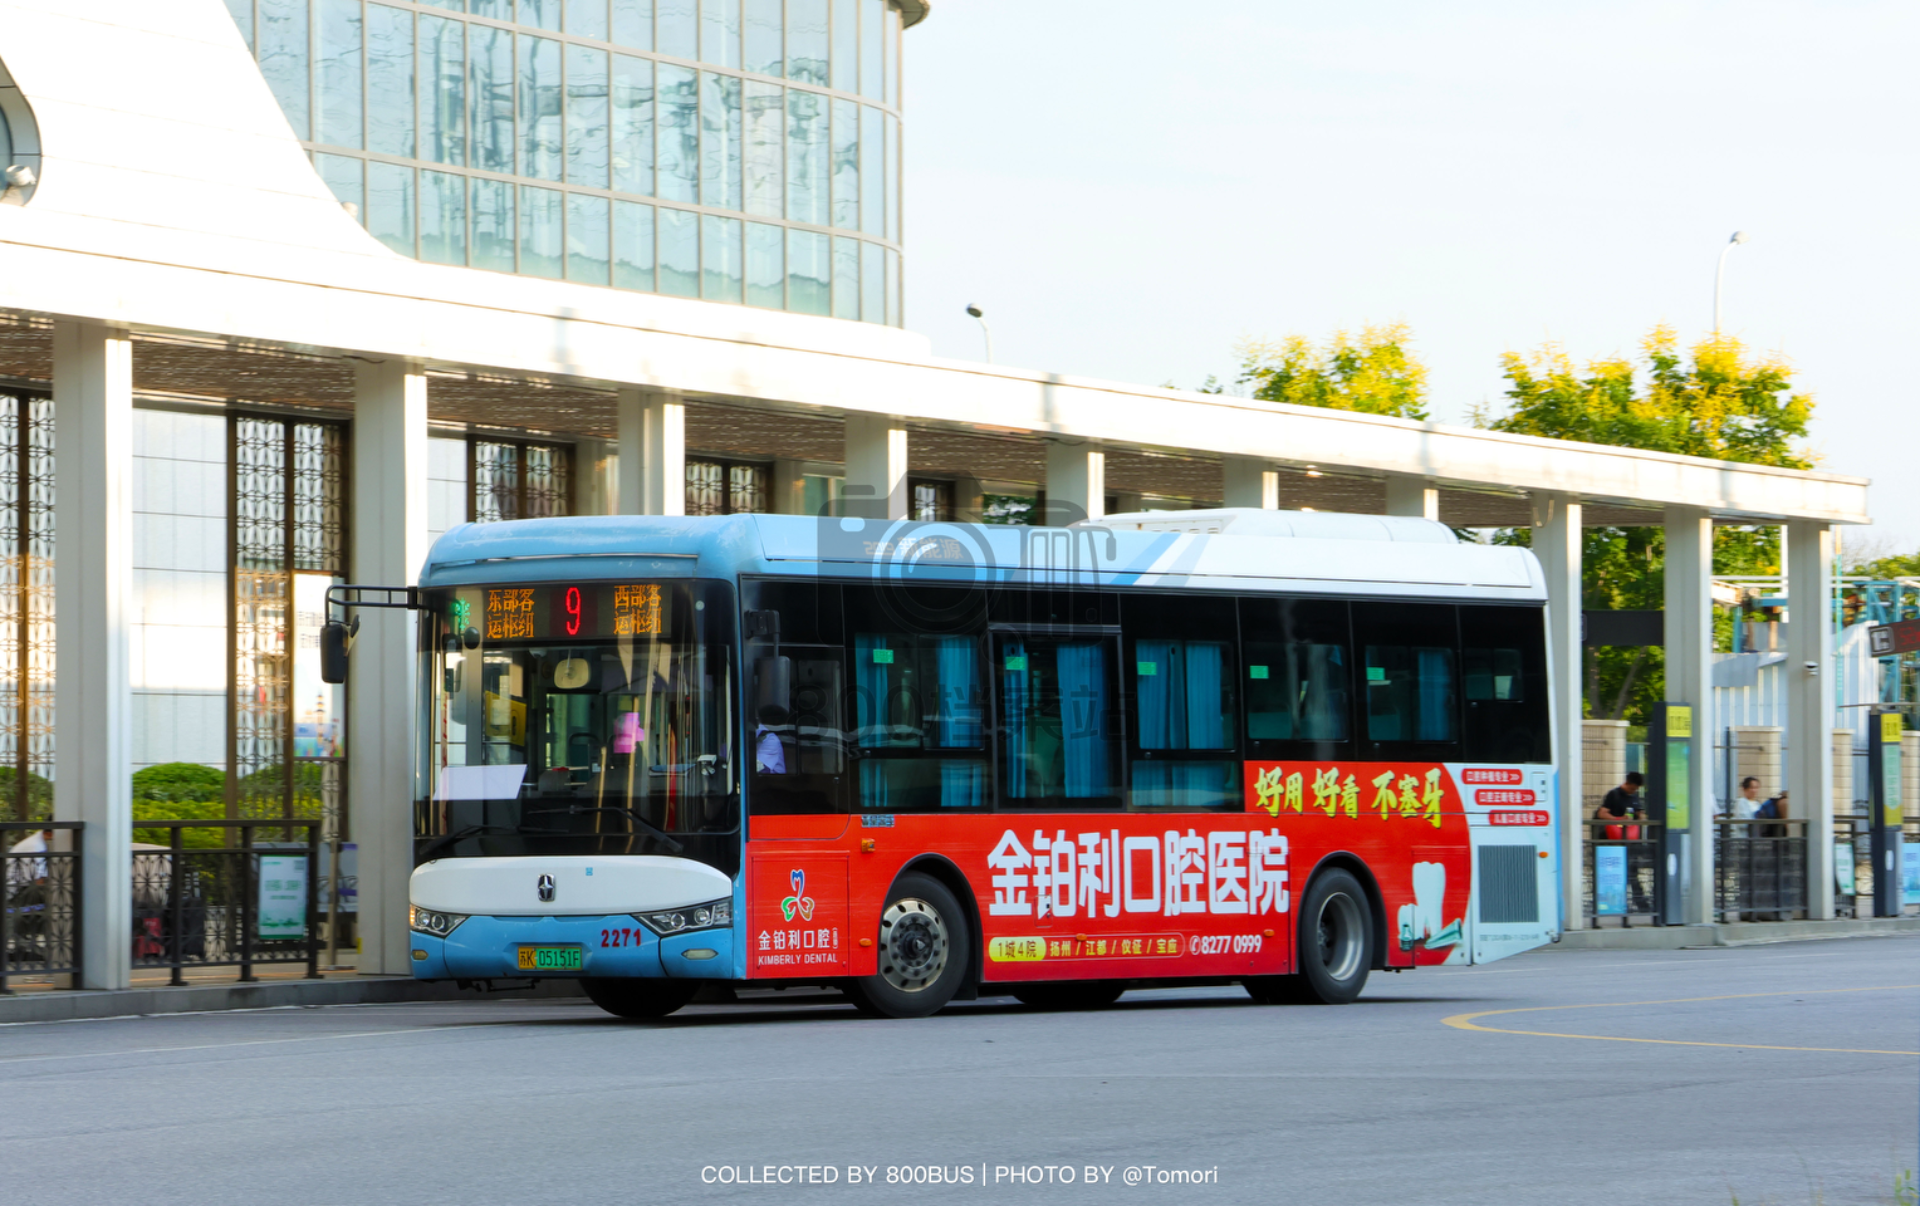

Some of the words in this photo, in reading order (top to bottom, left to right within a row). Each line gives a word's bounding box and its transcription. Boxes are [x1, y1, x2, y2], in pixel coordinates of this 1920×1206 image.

[897, 536, 964, 560] 新能源
[486, 588, 535, 613] 东部客
[613, 584, 662, 609] 西部客
[565, 586, 581, 635] 9
[613, 608, 662, 635] 运枢纽
[486, 613, 535, 639] 运枢纽
[1253, 766, 1304, 818] 好用
[1311, 767, 1361, 819] 好看
[1371, 768, 1445, 829] 不塞牙
[987, 828, 1290, 918] 金铂利口腔医院
[601, 928, 642, 948] 2271
[758, 928, 831, 951] 金铂利口腔
[997, 940, 1037, 958] 1城4院
[1050, 940, 1072, 957] 扬州
[1085, 940, 1107, 956] 江都
[1156, 938, 1178, 954] 宝应
[1201, 935, 1231, 955] 8277
[1233, 934, 1262, 953] 0999
[758, 954, 802, 966] KIMBERLY
[804, 953, 838, 964] DENTAL
